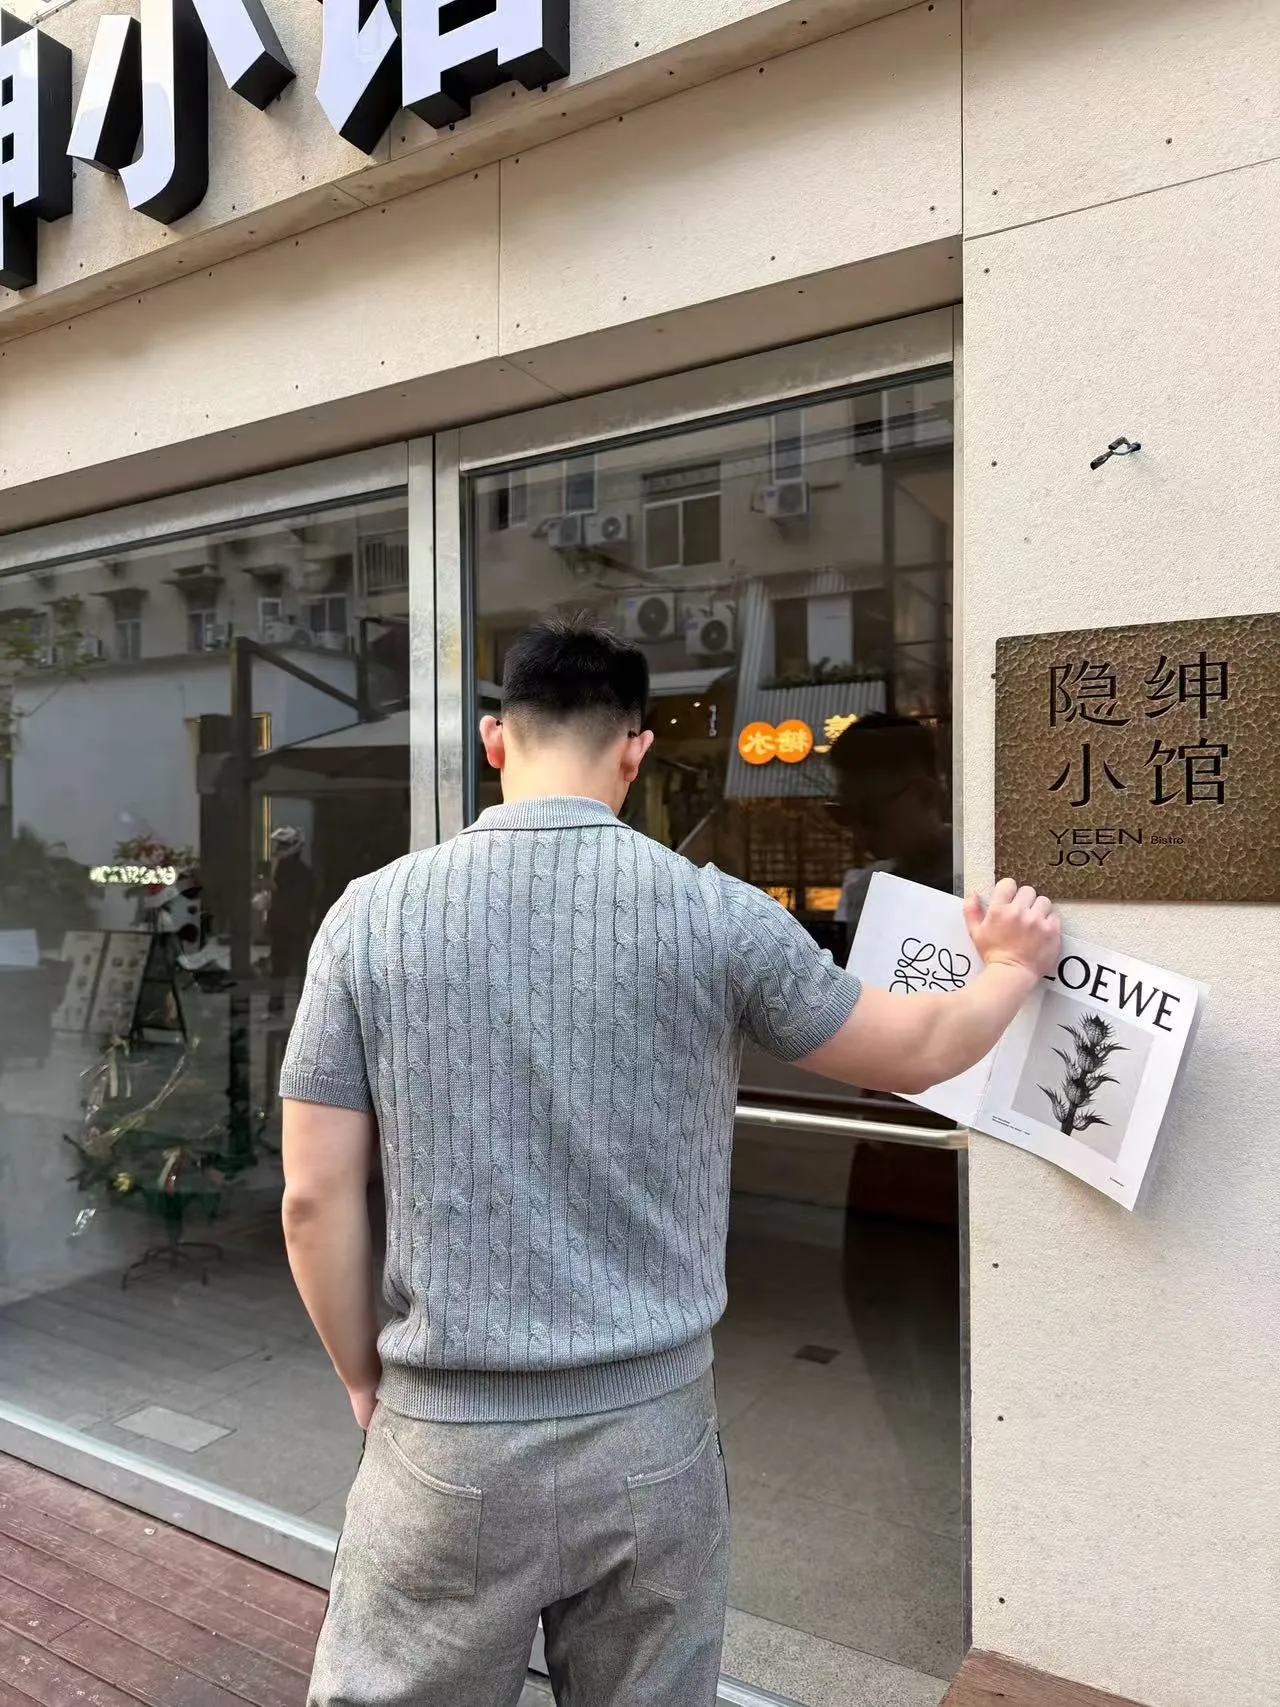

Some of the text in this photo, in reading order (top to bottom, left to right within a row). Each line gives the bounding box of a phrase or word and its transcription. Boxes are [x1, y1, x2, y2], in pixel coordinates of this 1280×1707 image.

[1049, 652, 1229, 728] 隐绅
[1048, 738, 1229, 808] 小馆
[1049, 828, 1184, 846] YEEN Bistro
[1049, 850, 1113, 867] JOY
[1043, 956, 1180, 1032] OEWE
